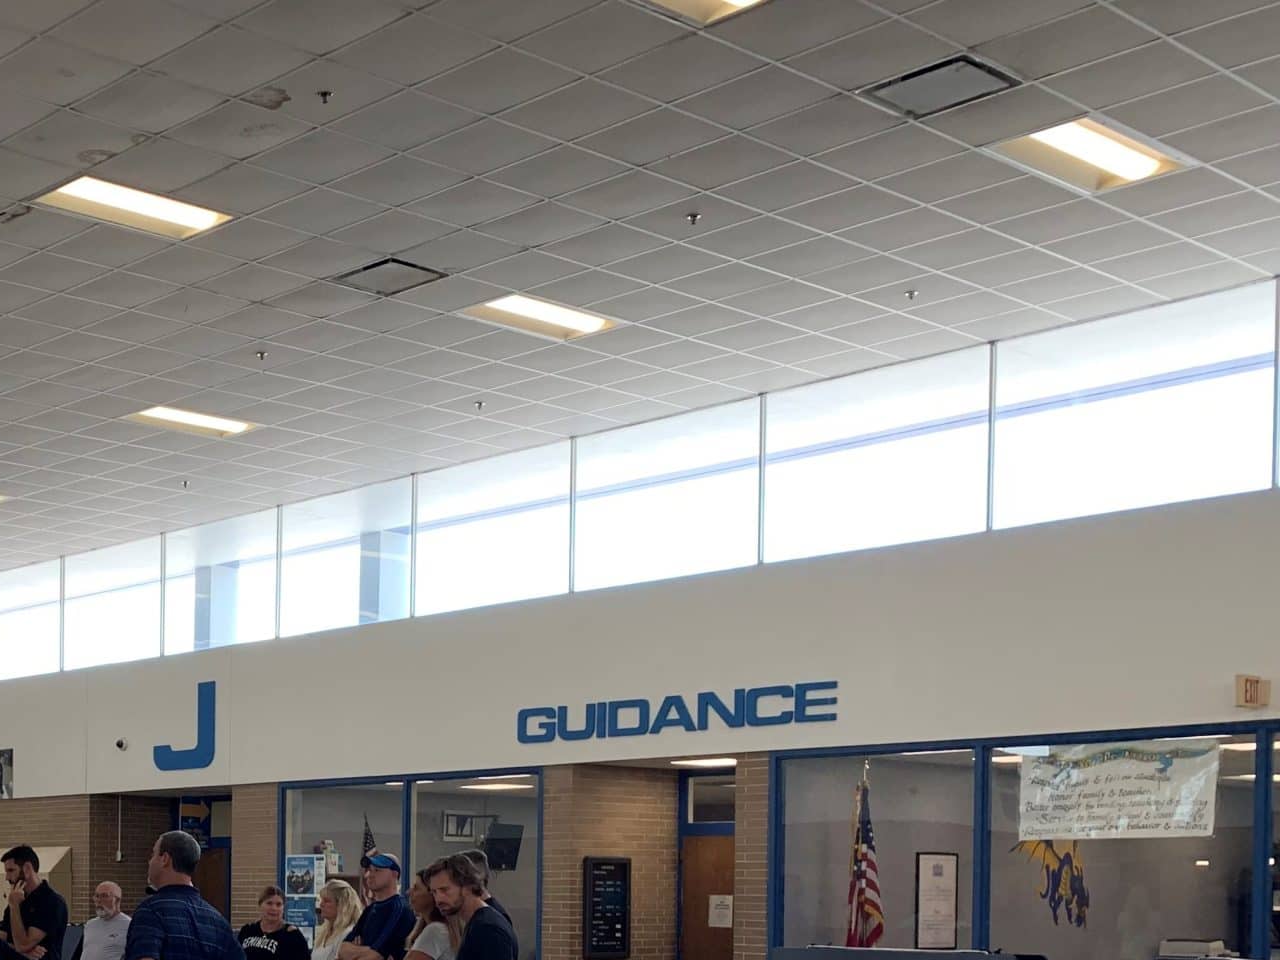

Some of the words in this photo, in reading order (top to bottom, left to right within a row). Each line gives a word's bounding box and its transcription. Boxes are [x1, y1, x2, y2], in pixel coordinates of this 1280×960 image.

[517, 680, 838, 744] GUIDANCE
[1245, 678, 1259, 704] EXIT
[153, 680, 216, 771] J
